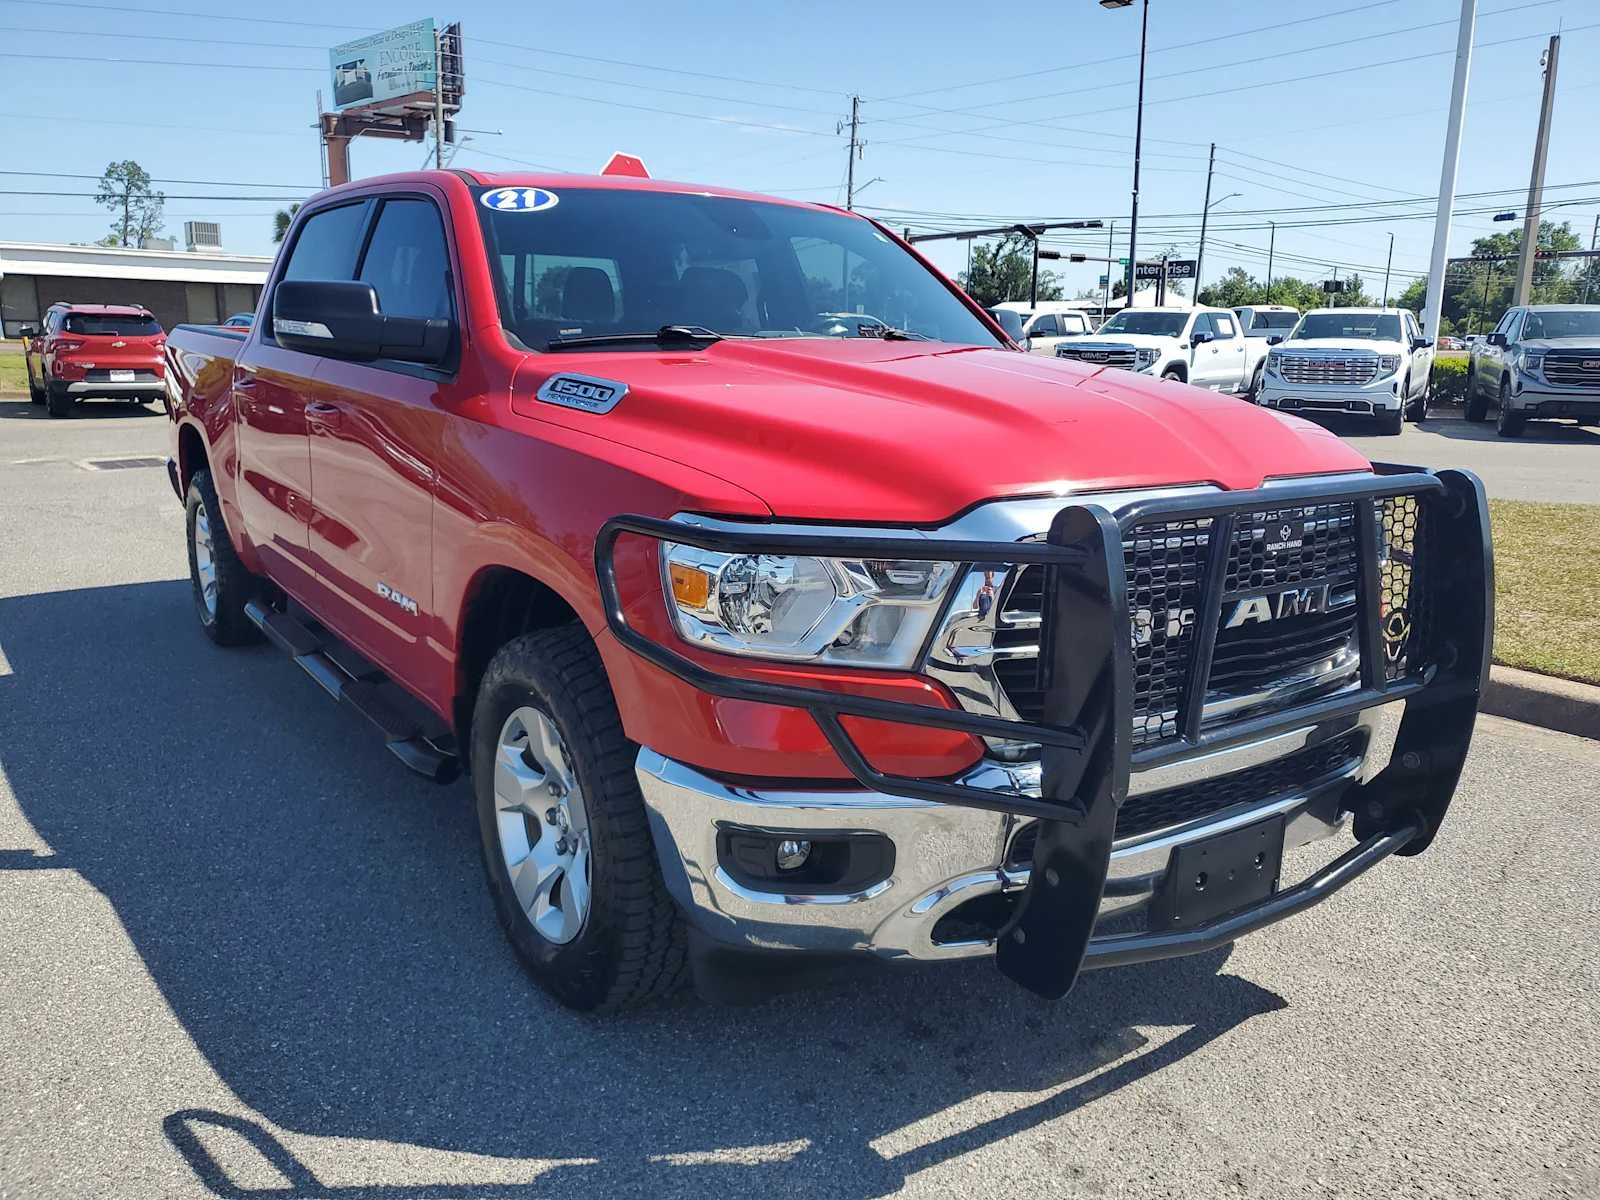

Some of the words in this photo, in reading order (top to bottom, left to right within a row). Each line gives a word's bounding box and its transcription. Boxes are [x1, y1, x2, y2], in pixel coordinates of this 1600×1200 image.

[380, 43, 421, 67] ENCORE
[496, 190, 535, 208] 21
[1136, 263, 1191, 276] nterrise
[1081, 352, 1108, 360] GMC
[554, 379, 613, 401] 1500
[1266, 543, 1286, 551] RANCH
[1286, 540, 1302, 549] HAND
[377, 581, 418, 616] RAM
